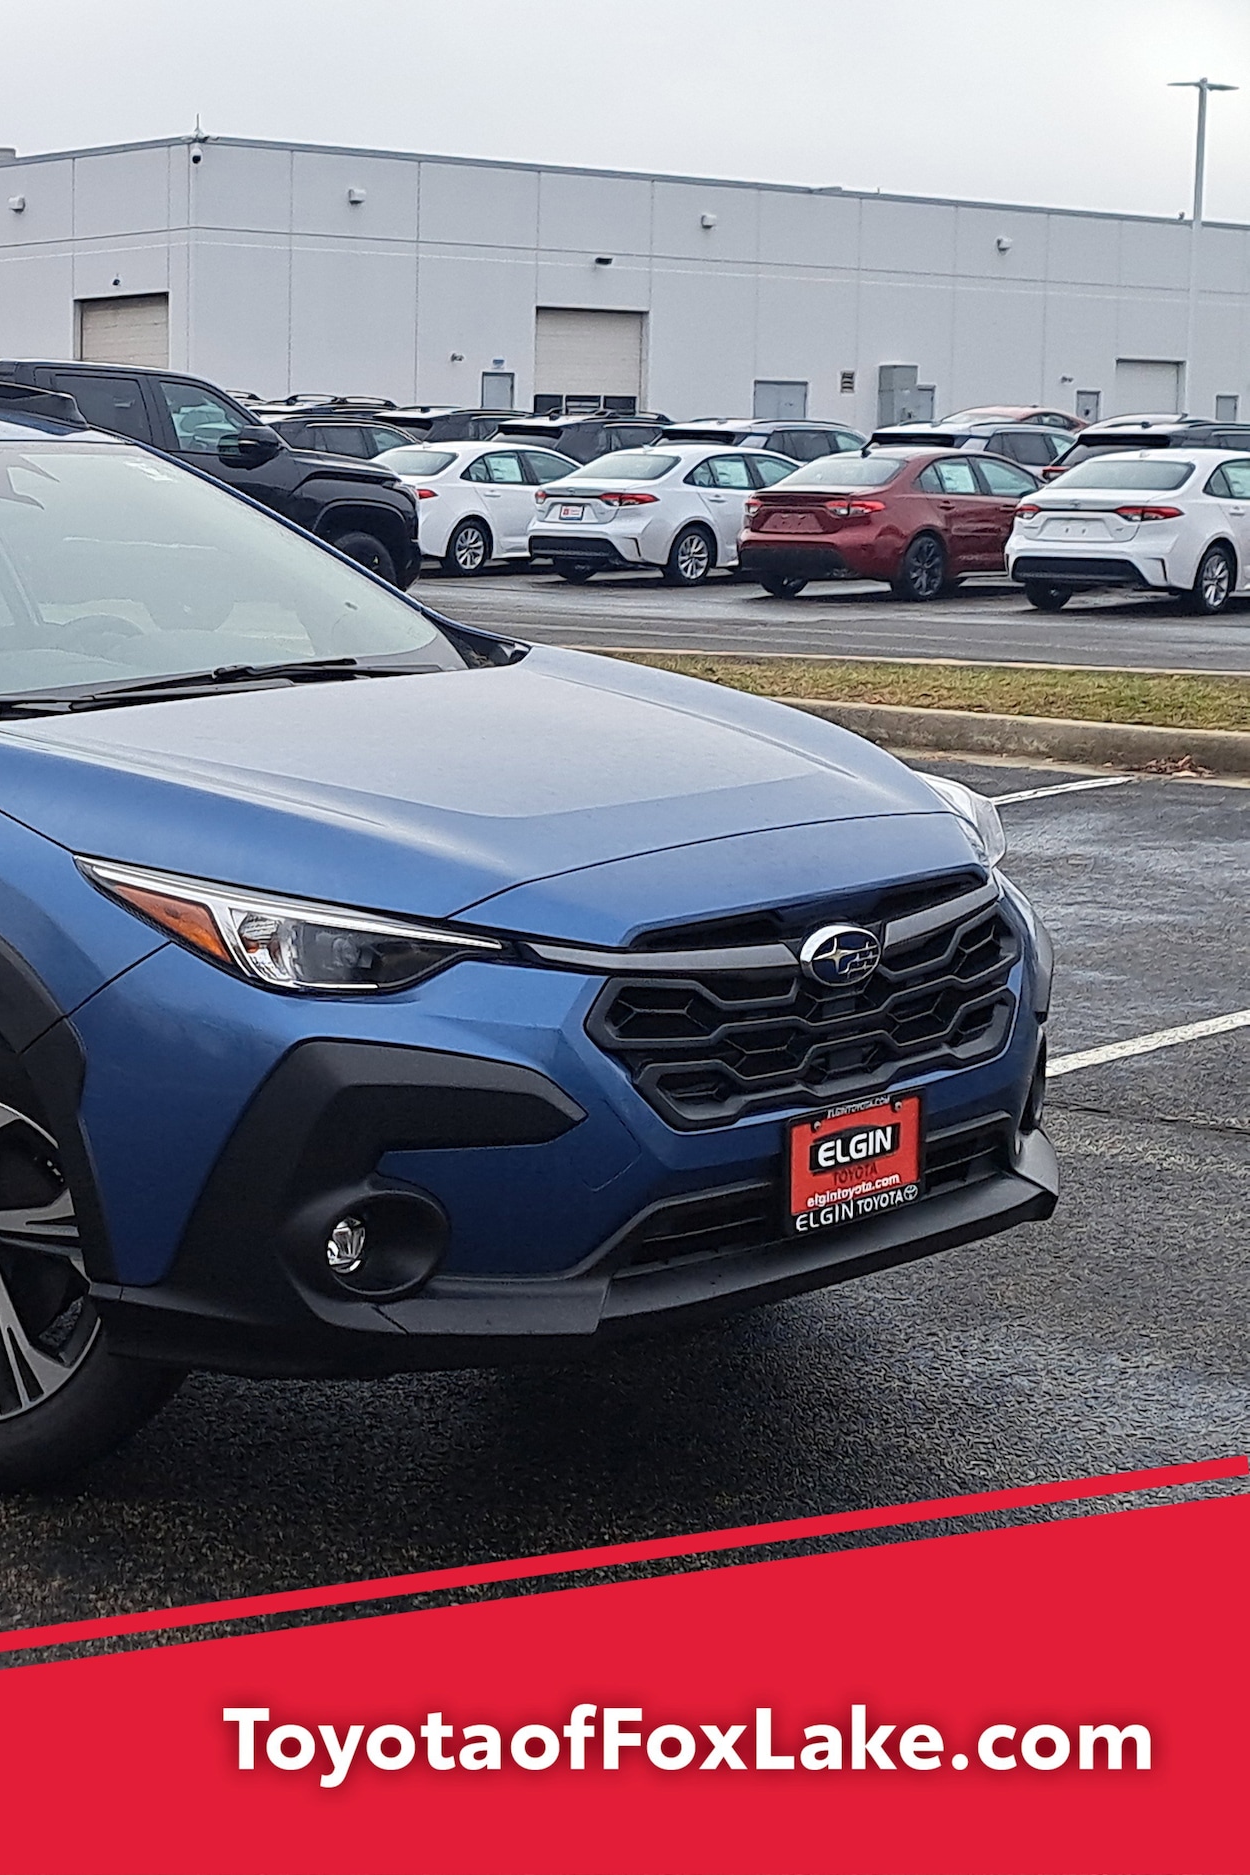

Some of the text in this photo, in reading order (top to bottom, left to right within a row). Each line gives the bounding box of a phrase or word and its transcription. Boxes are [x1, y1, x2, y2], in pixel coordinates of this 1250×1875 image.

[818, 1126, 892, 1167] ELGIN
[807, 1174, 900, 1207] elgintoyota.com
[833, 1163, 878, 1185] TOYOTA
[795, 1190, 904, 1232] ELGIN TOYOTA
